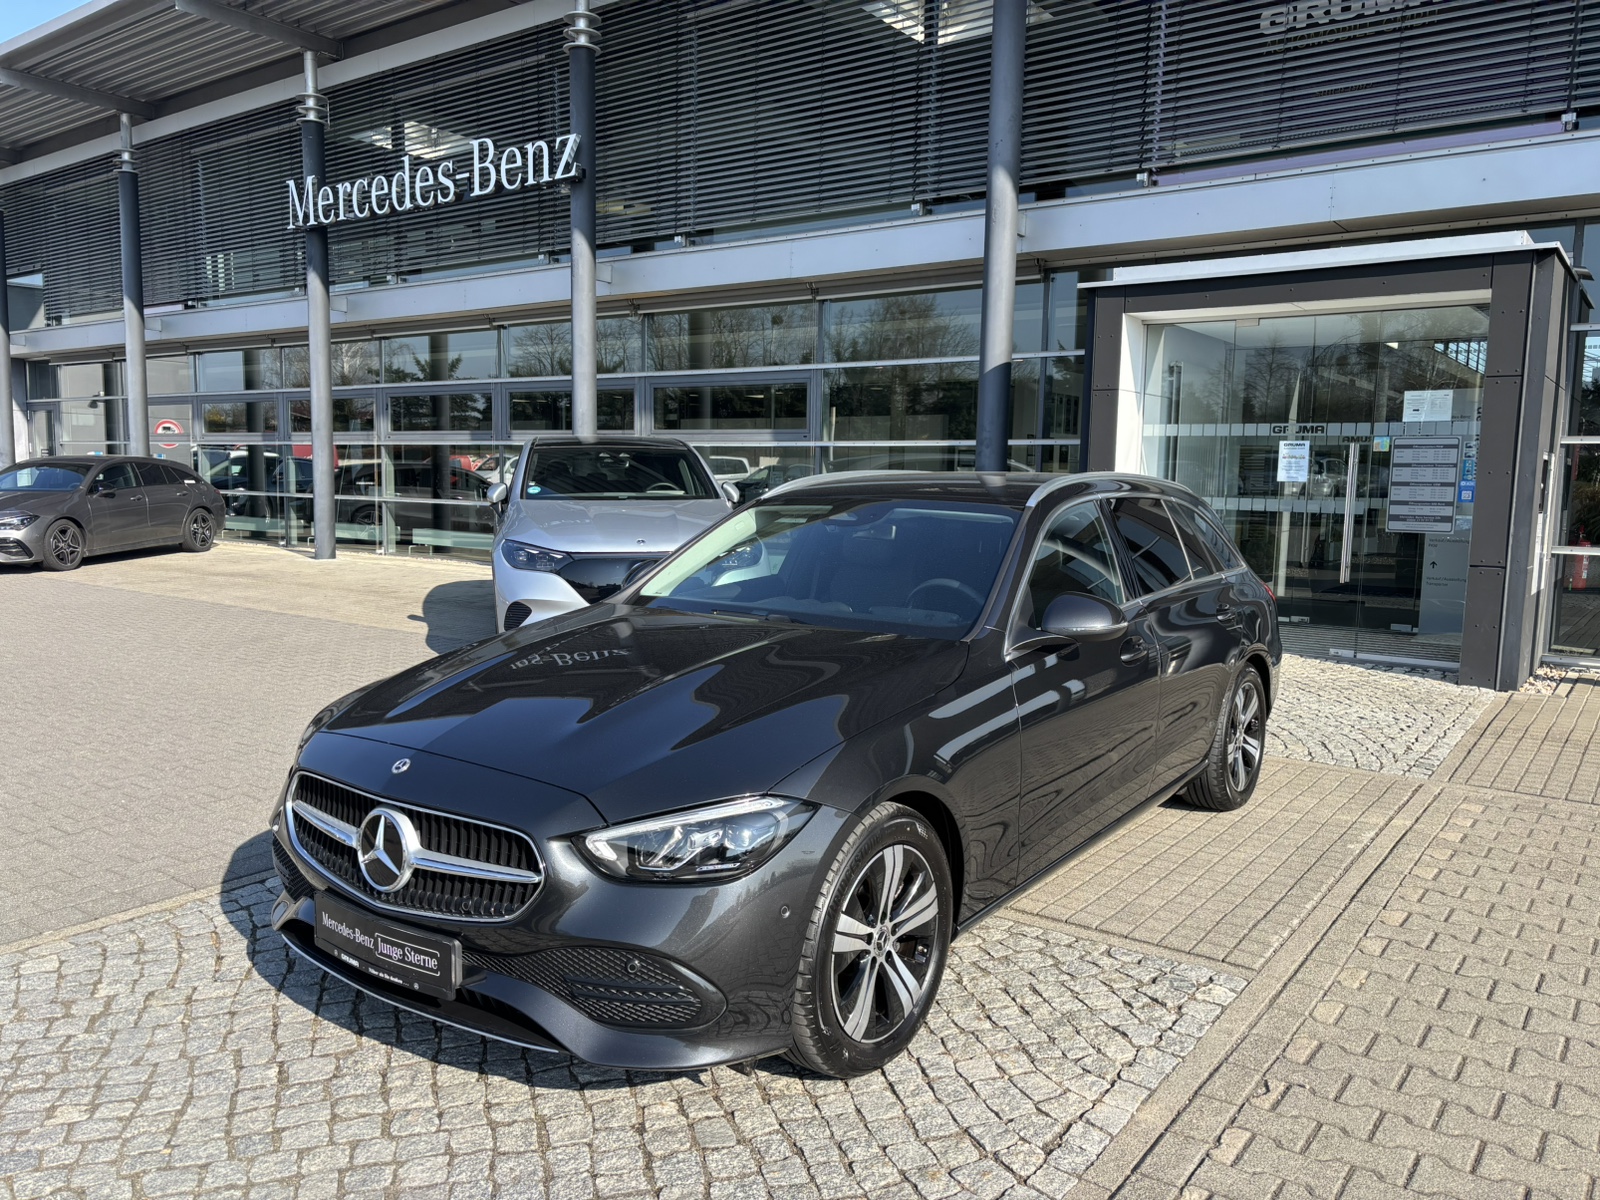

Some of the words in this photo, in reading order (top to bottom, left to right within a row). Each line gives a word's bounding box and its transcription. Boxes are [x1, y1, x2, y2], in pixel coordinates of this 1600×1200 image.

[286, 133, 581, 229] Mercedes-Benz
[321, 911, 375, 949] Mercedes-Benz
[377, 937, 403, 961] Junge
[404, 946, 438, 970] Sterne
